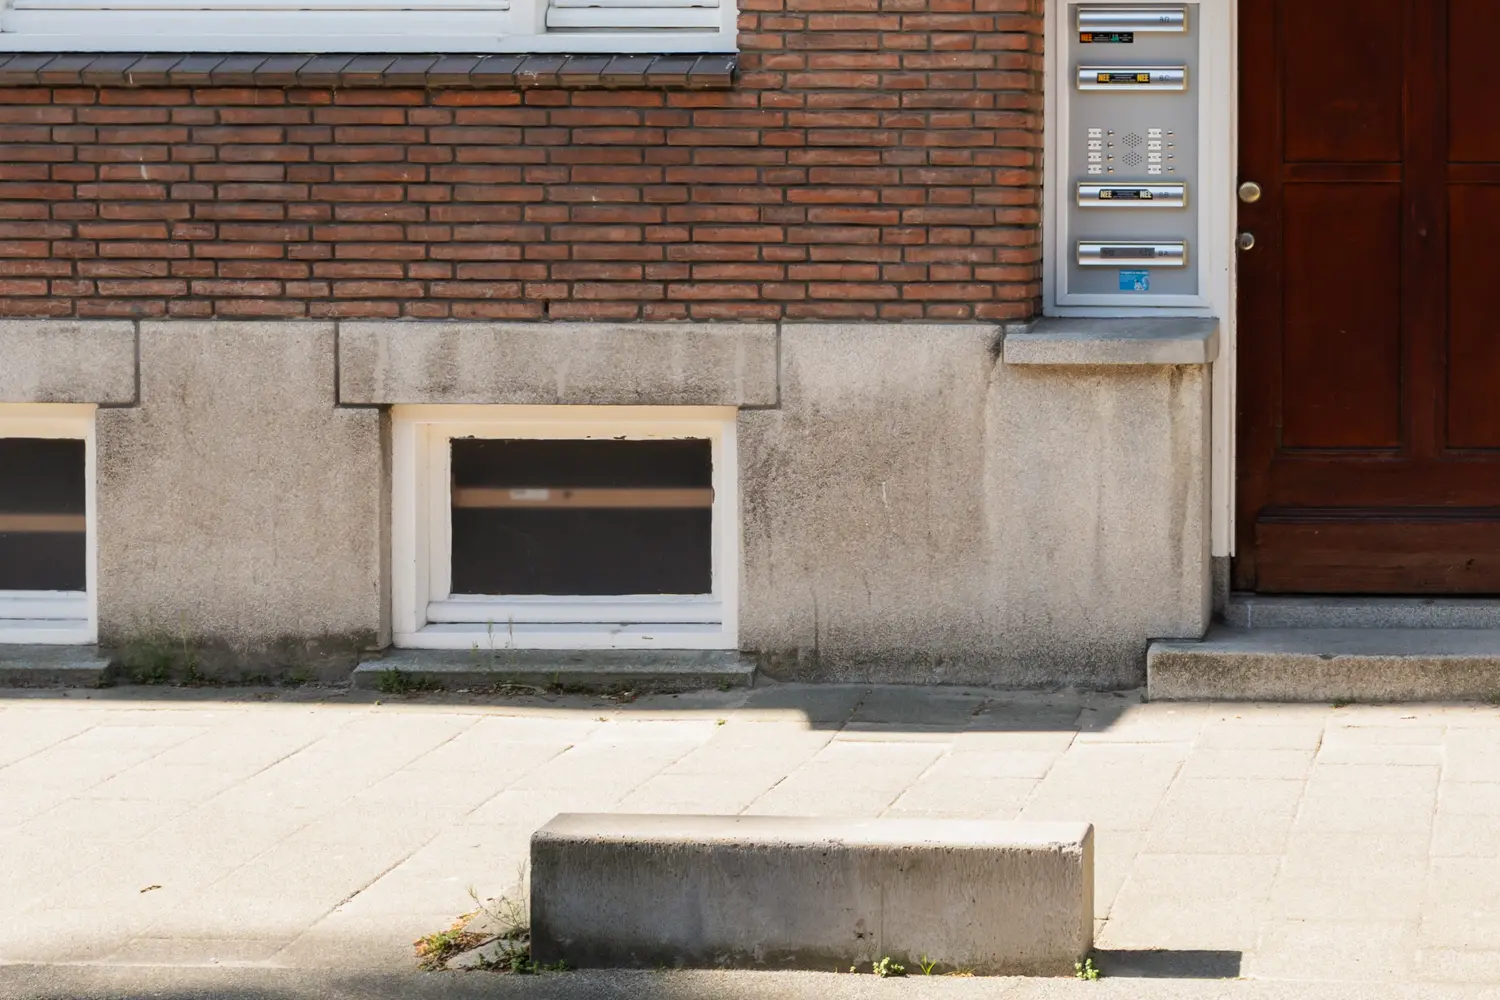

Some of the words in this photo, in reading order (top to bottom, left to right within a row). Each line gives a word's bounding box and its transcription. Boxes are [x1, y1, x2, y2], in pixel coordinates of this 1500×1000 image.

[1098, 73, 1110, 82] NEE
[1137, 73, 1149, 82] NEE
[1100, 190, 1112, 198] NEE
[1140, 190, 1152, 198] NEE
